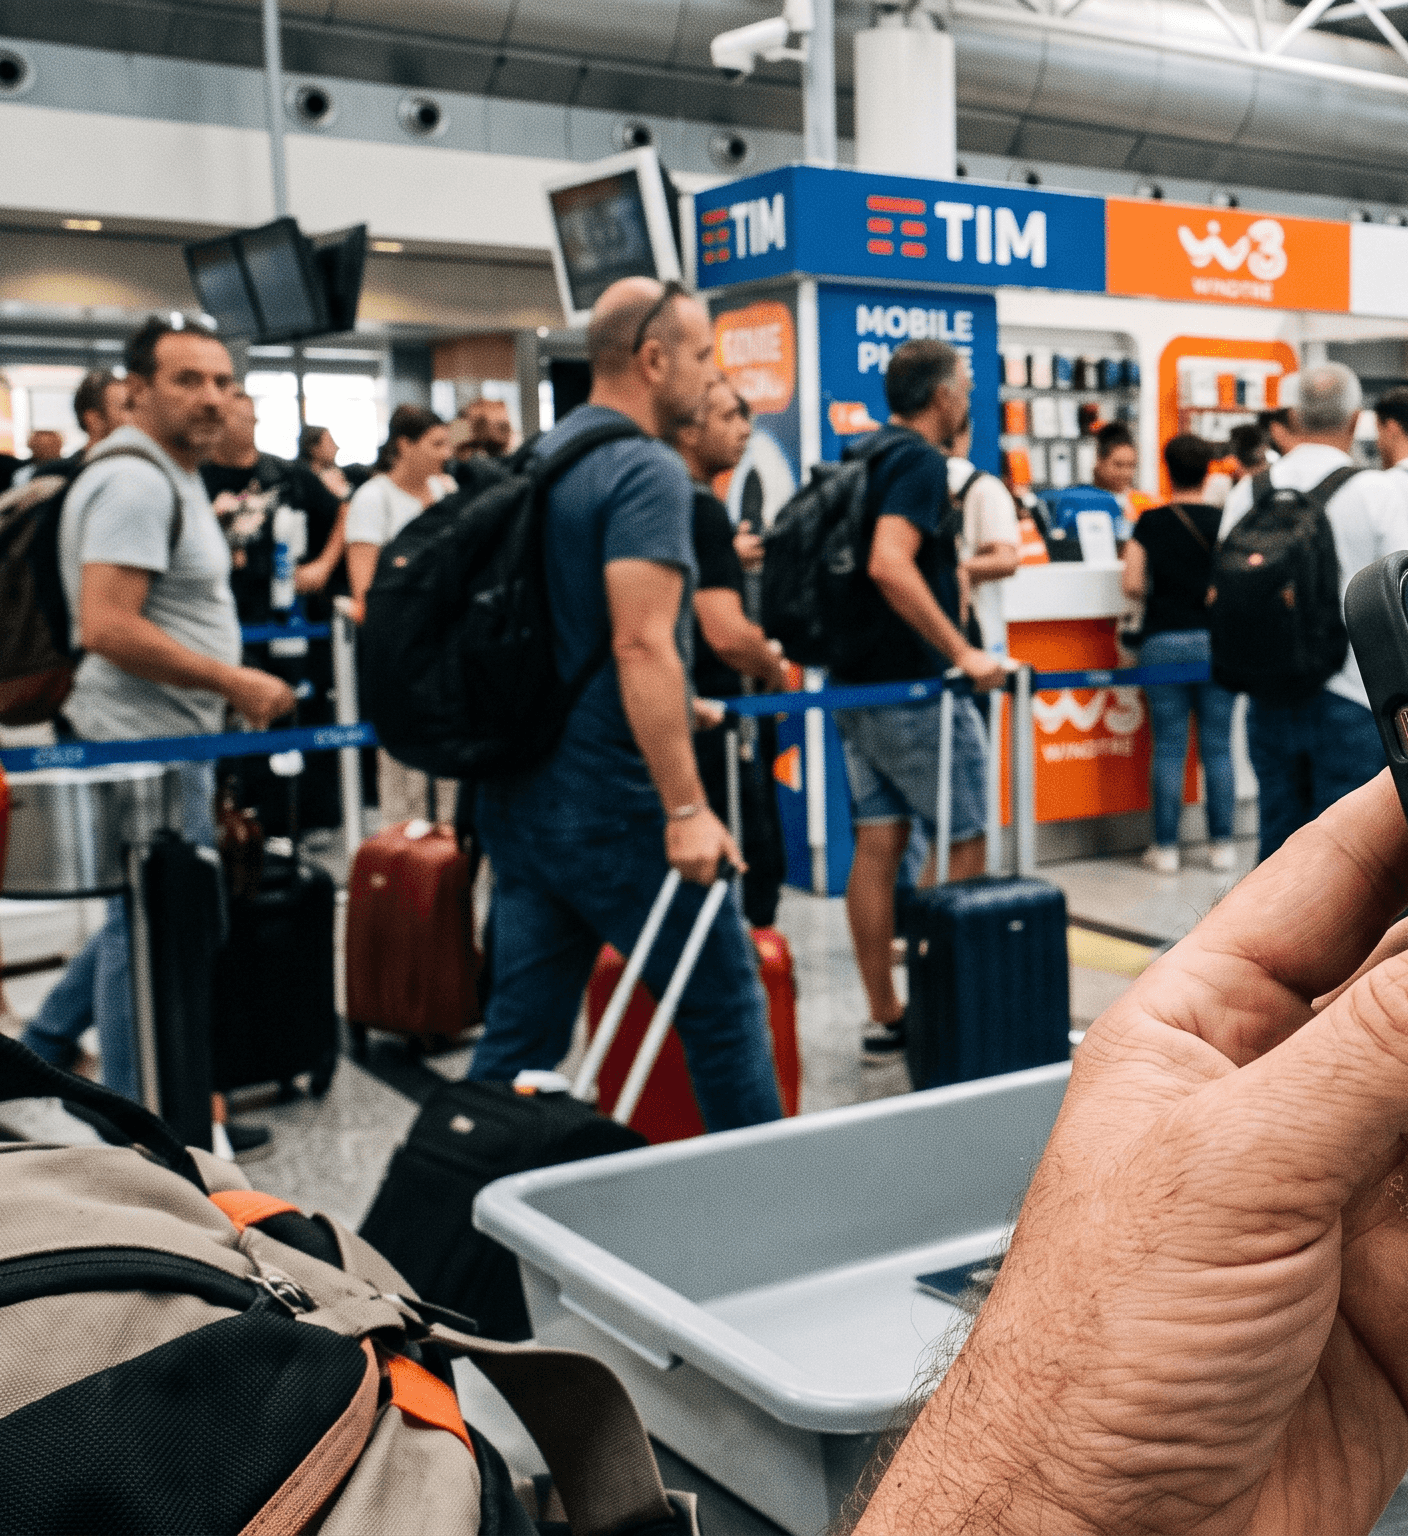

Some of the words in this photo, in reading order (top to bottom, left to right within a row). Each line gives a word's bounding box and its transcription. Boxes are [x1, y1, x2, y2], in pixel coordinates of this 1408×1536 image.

[729, 193, 786, 260] TIM
[934, 200, 1047, 269] TIM
[856, 304, 974, 342] MOBILE
